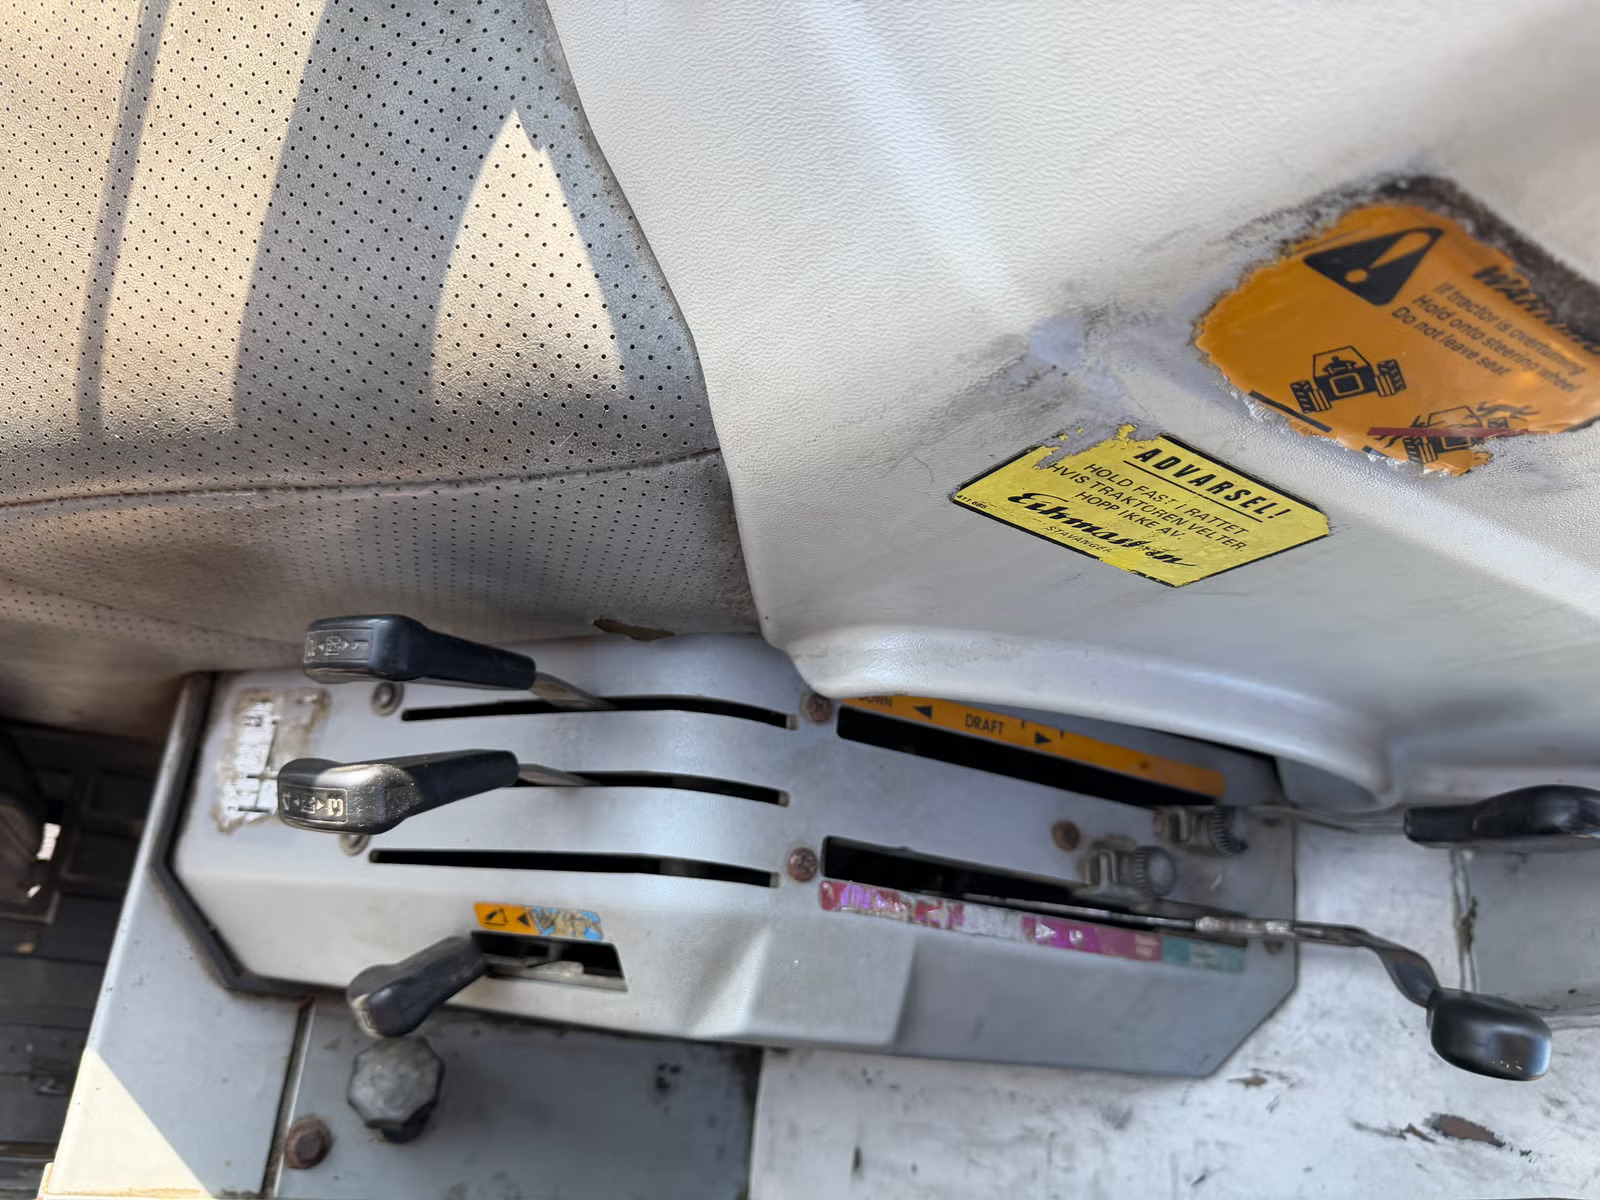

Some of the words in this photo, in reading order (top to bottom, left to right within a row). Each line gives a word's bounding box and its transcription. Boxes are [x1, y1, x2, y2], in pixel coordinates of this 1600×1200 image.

[1391, 306, 1417, 325] Do
[1414, 321, 1445, 339] not
[1440, 334, 1480, 360] leave
[1476, 357, 1512, 376] seat
[1412, 294, 1456, 321] Hold
[1449, 319, 1486, 341] onto
[1481, 338, 1540, 372] steering
[1446, 290, 1500, 323] tractor
[1494, 319, 1513, 333] is
[1046, 463, 1090, 484] HVIS
[1089, 481, 1189, 526] TRAKTOREN
[1187, 523, 1247, 552] VELTER.
[1075, 491, 1121, 511] HOPP
[1118, 510, 1161, 528] IKKE
[1083, 463, 1134, 487] HOLD
[1132, 485, 1179, 504] FAST
[1184, 508, 1249, 535] RATTET
[1133, 448, 1292, 519] ADVARSEL!
[964, 713, 1005, 735] DRAFT
